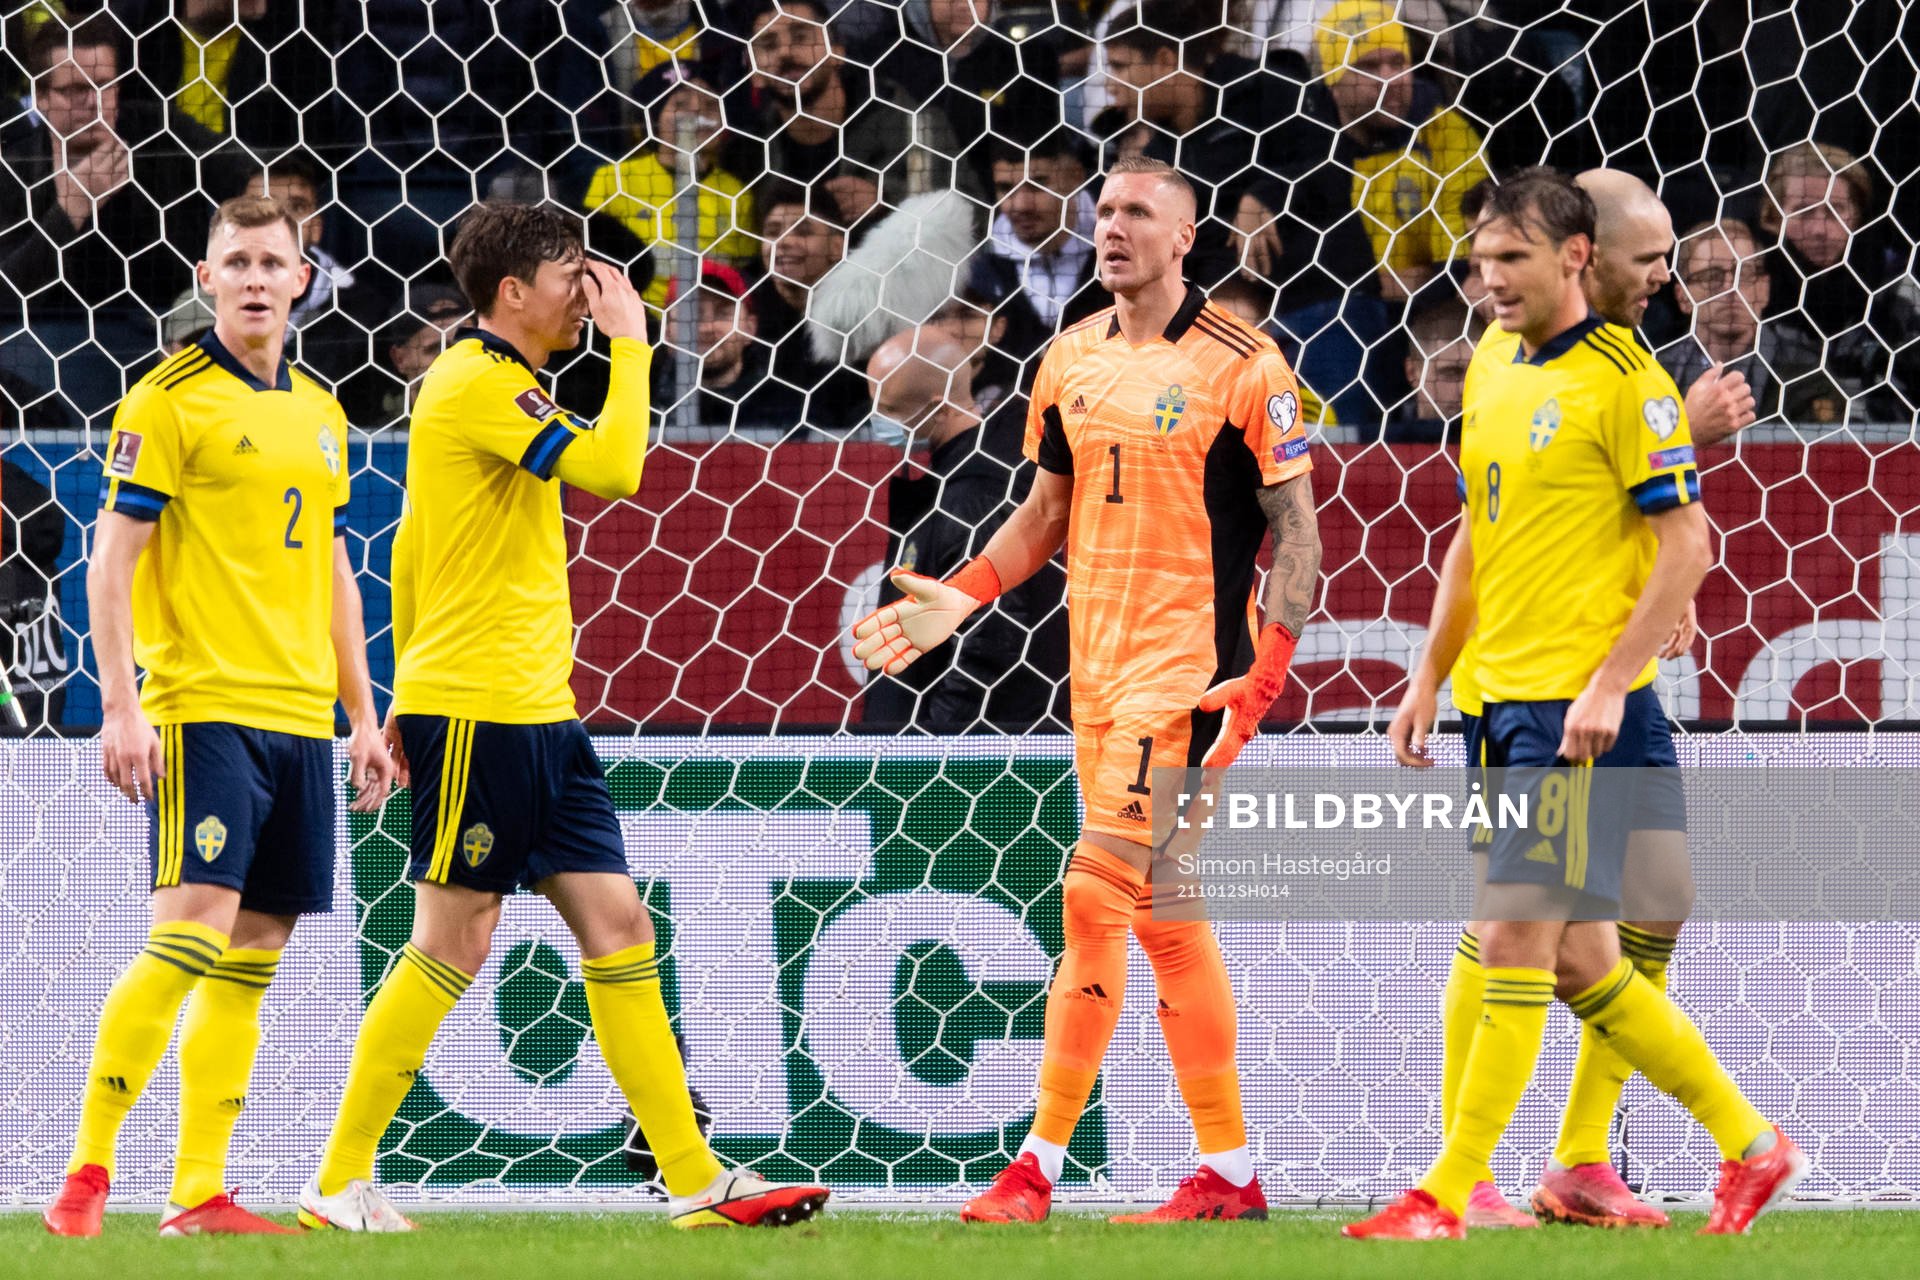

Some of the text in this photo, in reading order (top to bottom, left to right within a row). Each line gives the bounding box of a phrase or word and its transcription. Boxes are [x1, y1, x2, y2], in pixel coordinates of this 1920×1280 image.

[1106, 443, 1123, 504] 1
[1487, 461, 1501, 523] 8
[283, 487, 303, 549] 2
[1127, 736, 1152, 795] 1
[1536, 772, 1568, 837] 8
